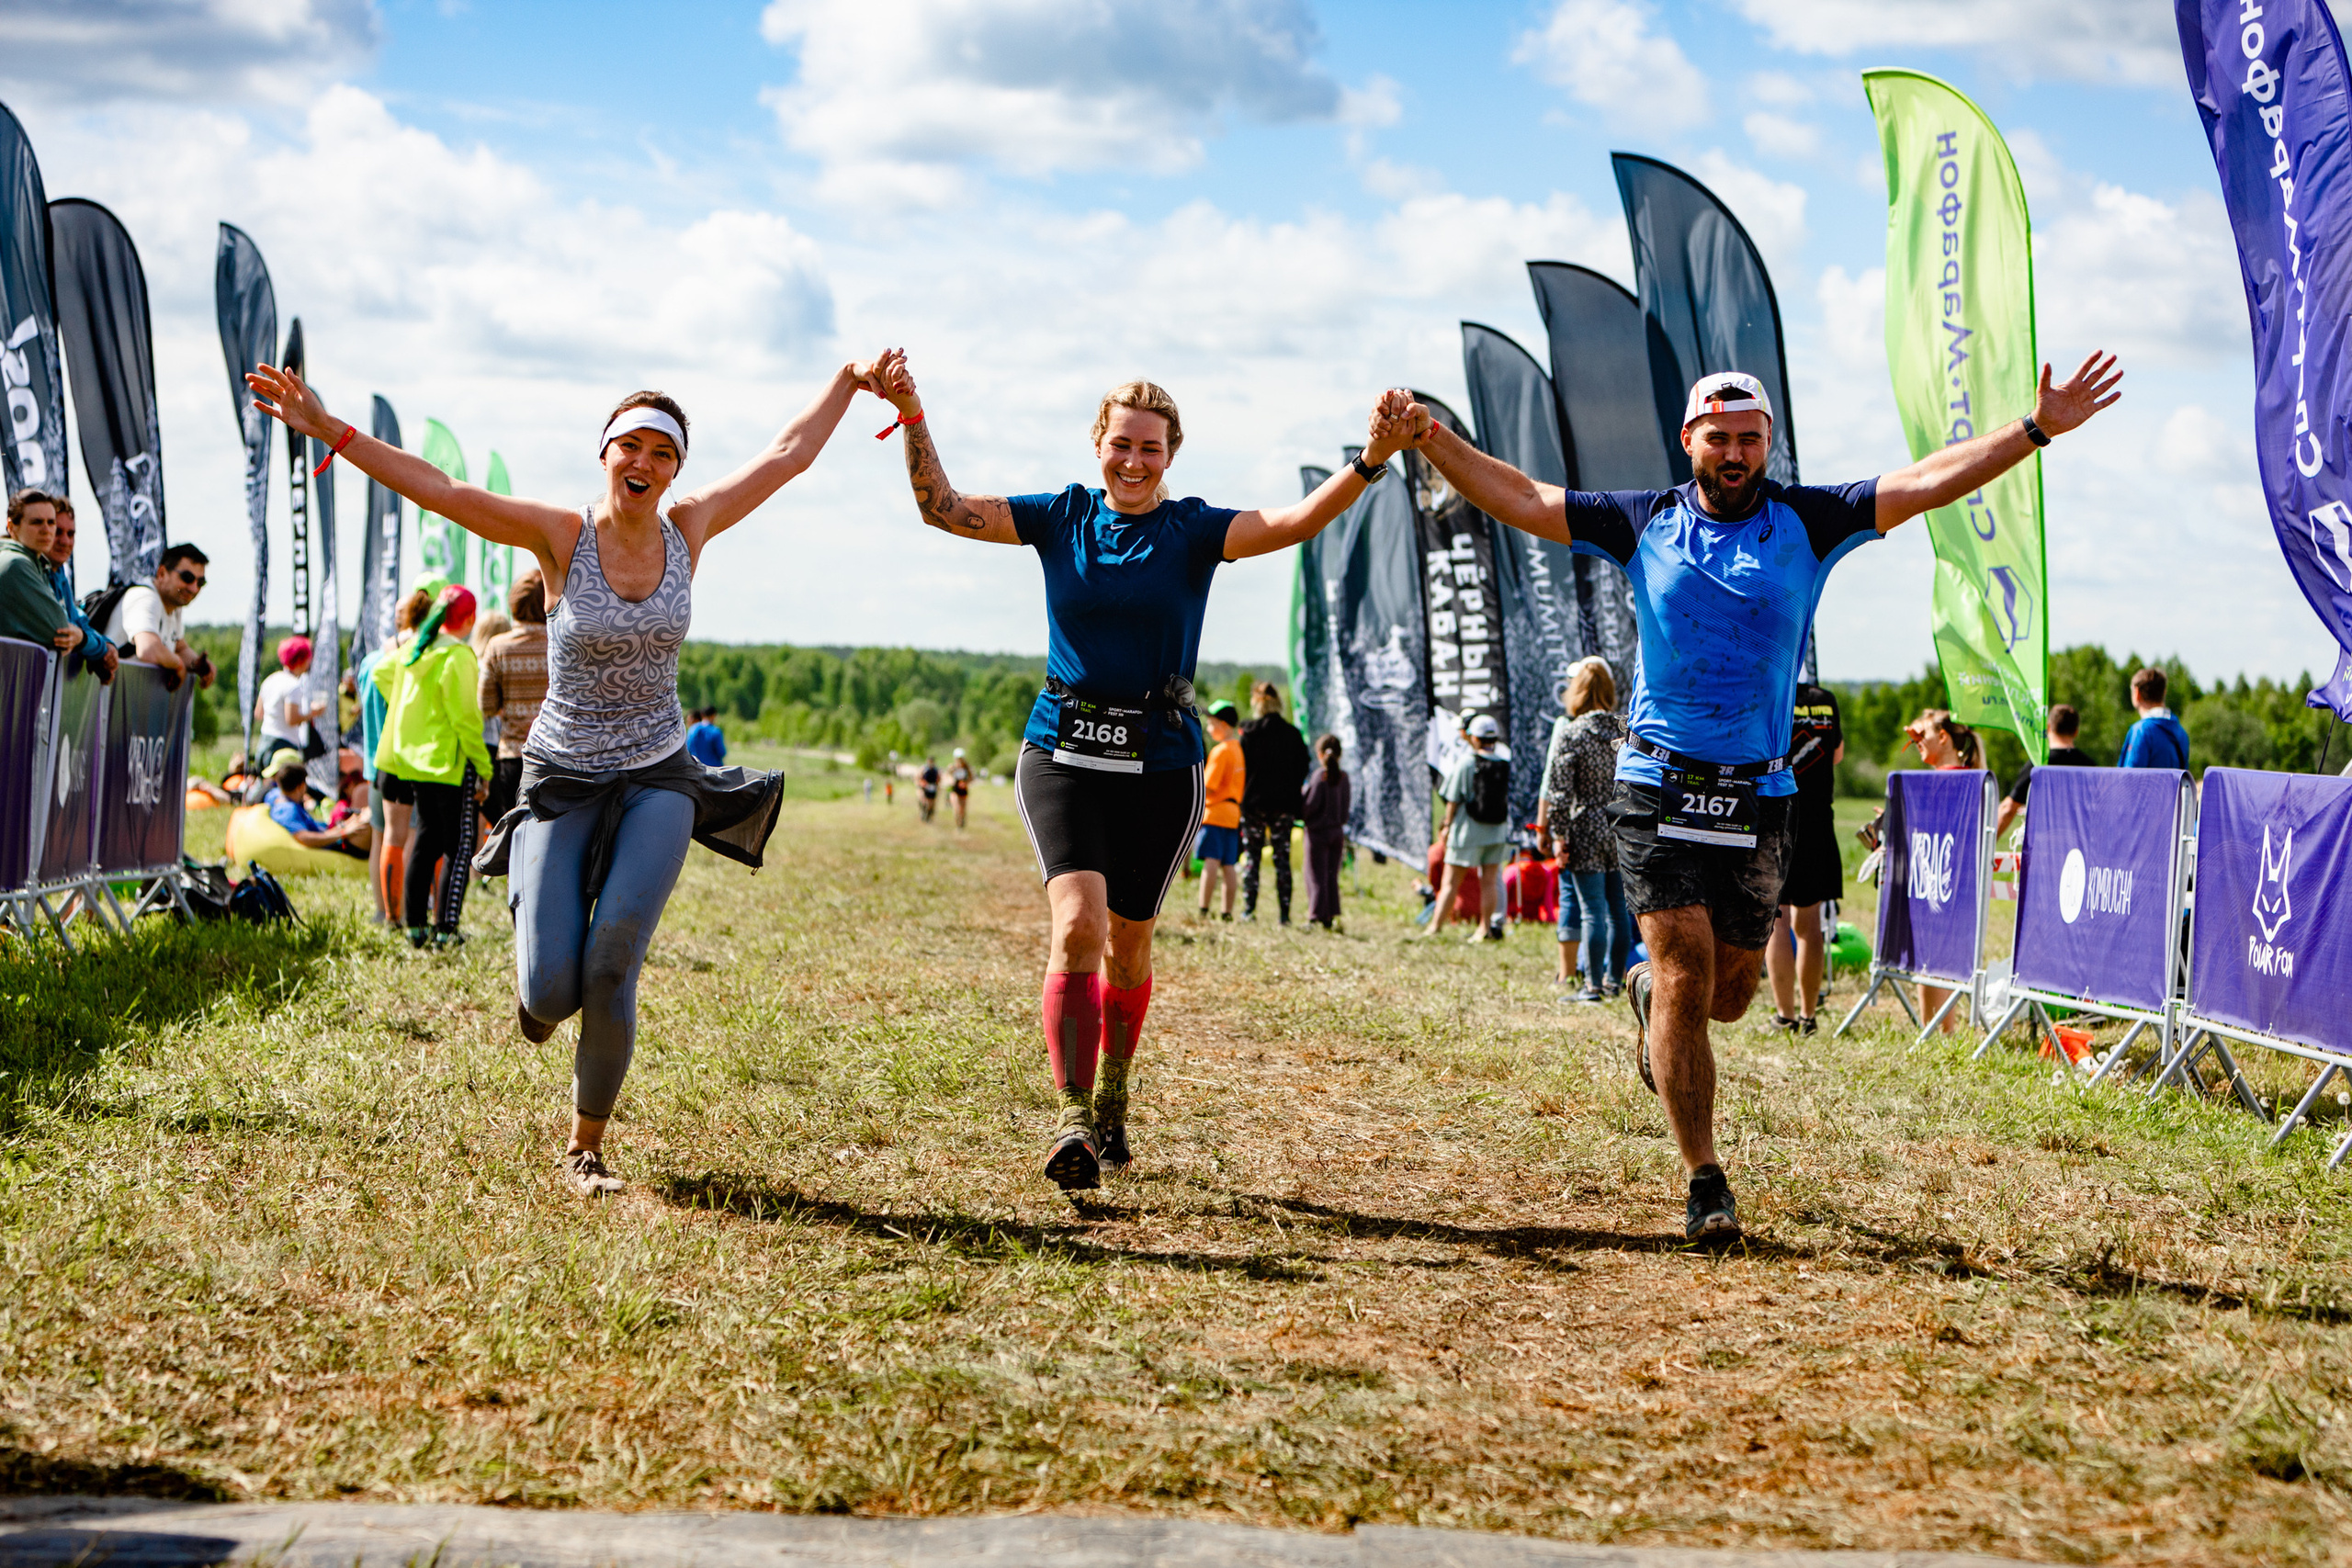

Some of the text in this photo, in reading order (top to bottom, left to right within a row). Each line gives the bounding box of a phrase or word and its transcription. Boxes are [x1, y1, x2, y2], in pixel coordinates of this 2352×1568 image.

[1426, 549, 1461, 698] КАБАН
[1450, 533, 1499, 708] ЧЁРНЫЙ
[1071, 718, 1128, 746] 2168
[1680, 793, 1739, 818] 2167
[2086, 866, 2133, 919] KOMBUCHA
[2274, 946, 2295, 979] FOX
